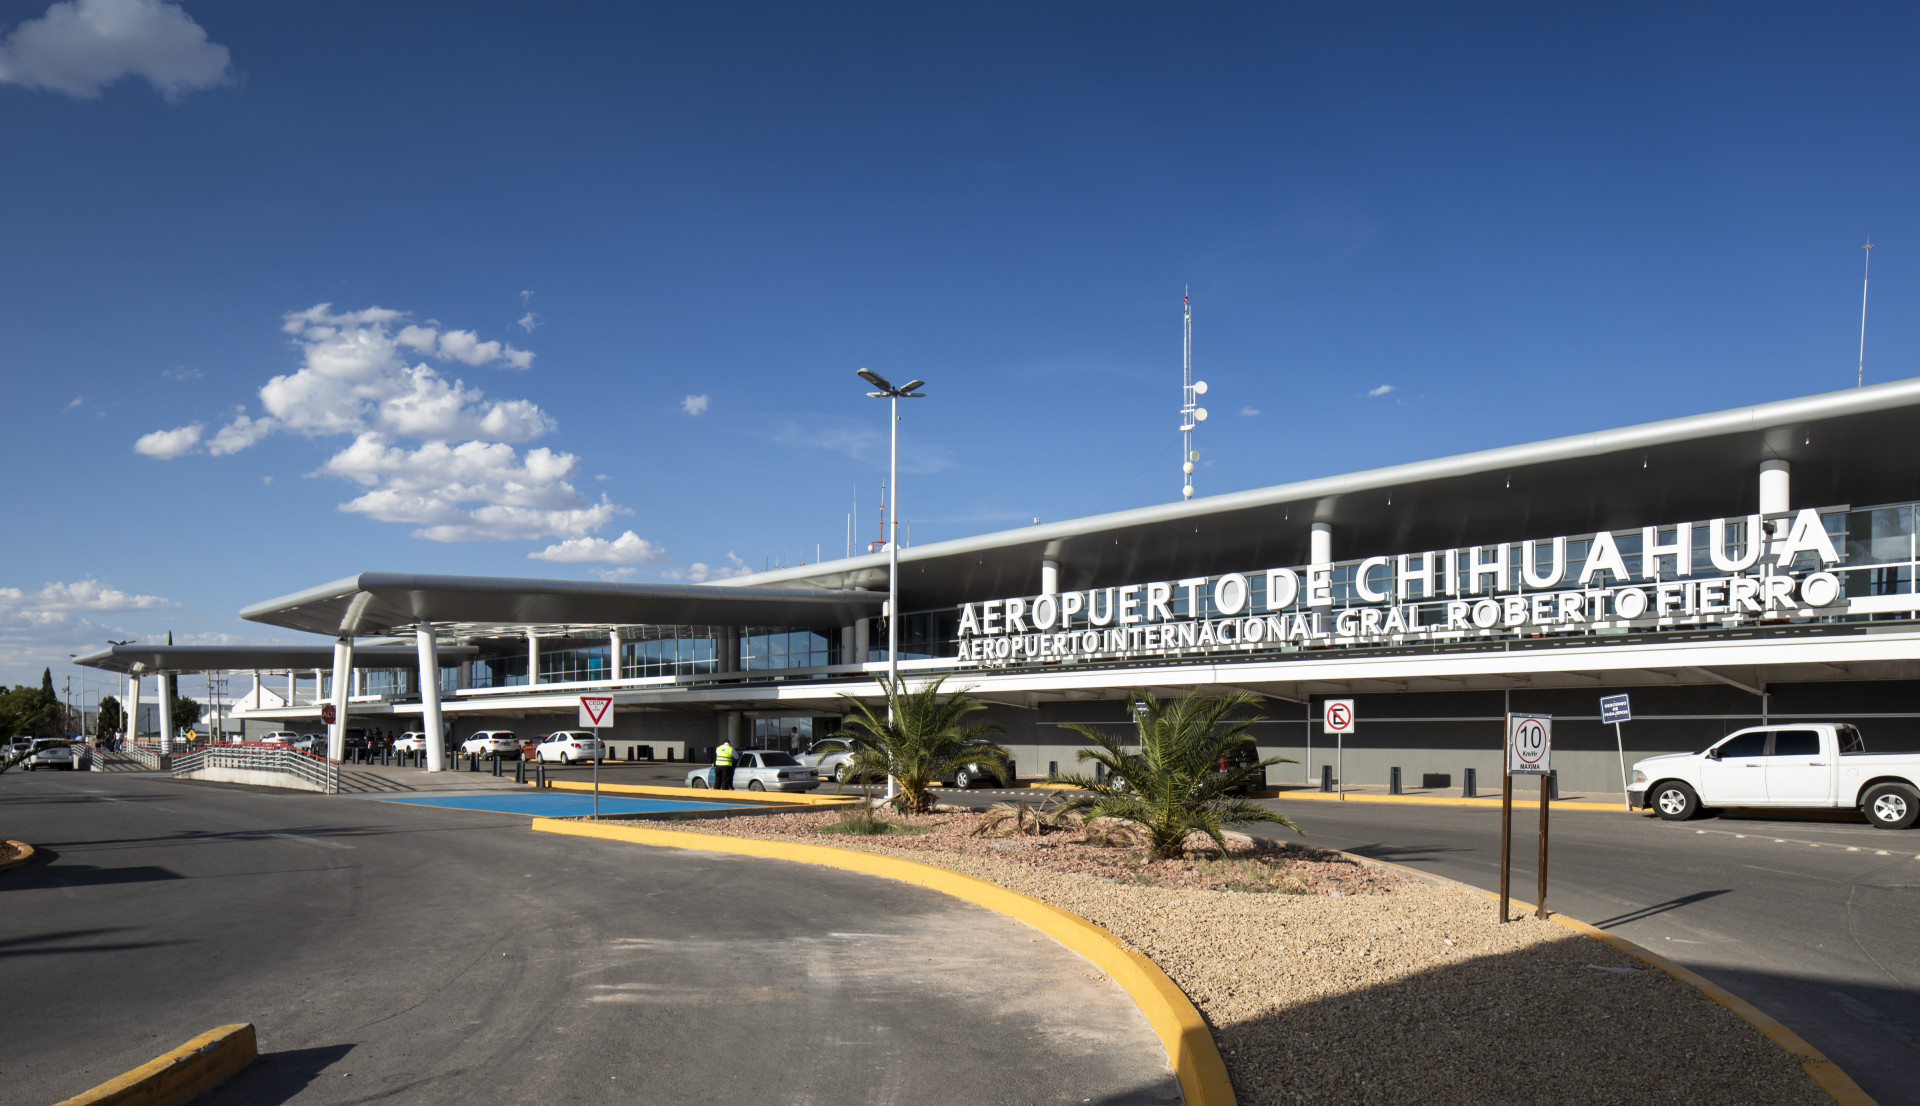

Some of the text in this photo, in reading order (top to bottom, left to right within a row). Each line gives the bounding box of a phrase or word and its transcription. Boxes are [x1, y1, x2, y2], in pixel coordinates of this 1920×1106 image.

[957, 507, 1841, 637] AEROPUERTO DE CHIHUAHUA
[957, 571, 1841, 661] AEROPUERTO INTERNACIONAL GRAL. ROBERTO FIERRO
[1520, 725, 1542, 749] 10
